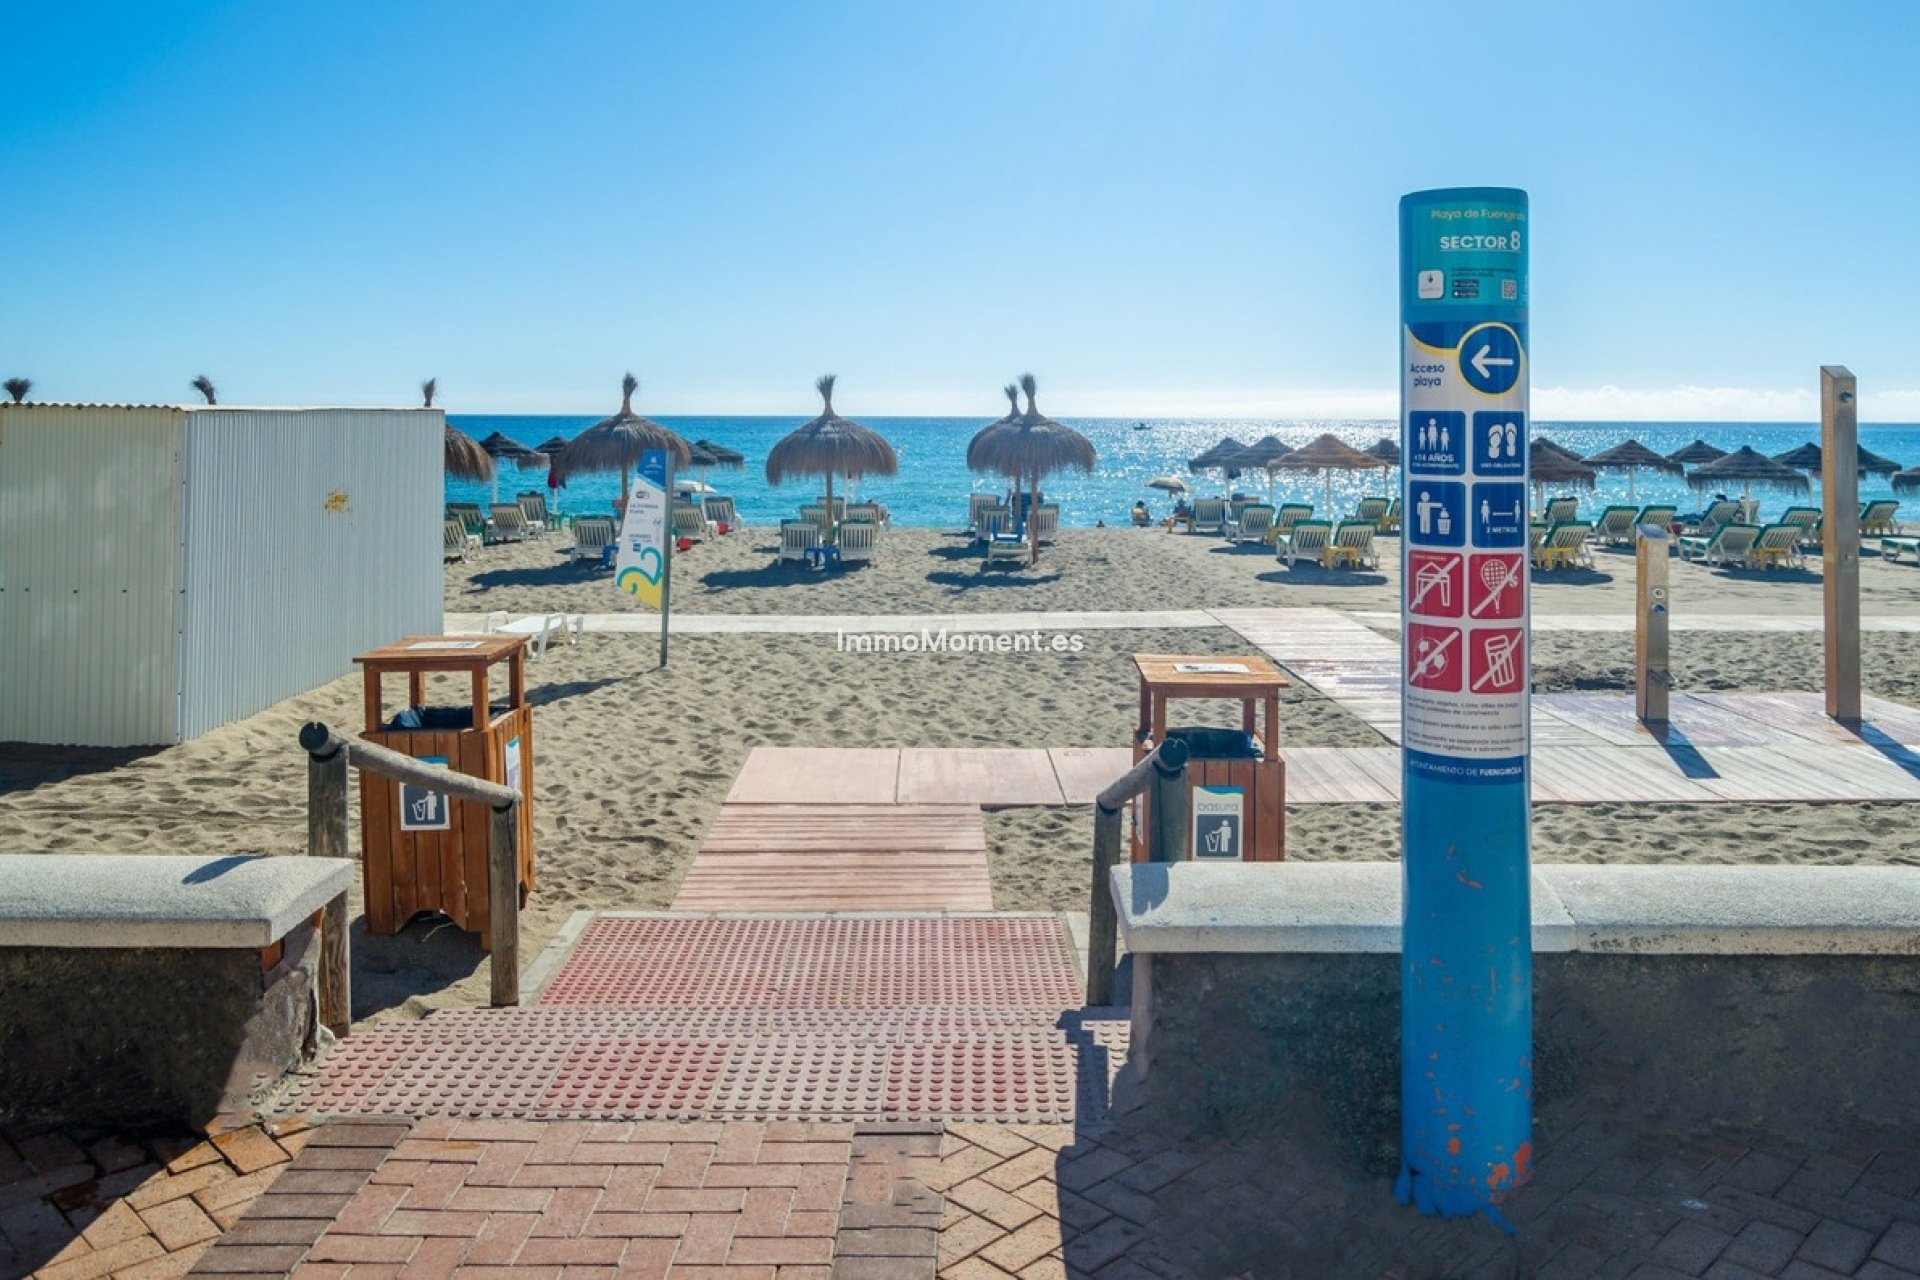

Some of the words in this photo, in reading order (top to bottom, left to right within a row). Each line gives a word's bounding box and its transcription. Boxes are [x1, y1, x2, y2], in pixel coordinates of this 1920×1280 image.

[1431, 208, 1462, 221] Playa
[1464, 208, 1478, 218] de
[1440, 236, 1507, 249] SECTOR
[1510, 231, 1521, 250] 8
[1410, 363, 1445, 374] Acceso
[1413, 375, 1442, 390] playa
[1428, 453, 1454, 463] AÑOS
